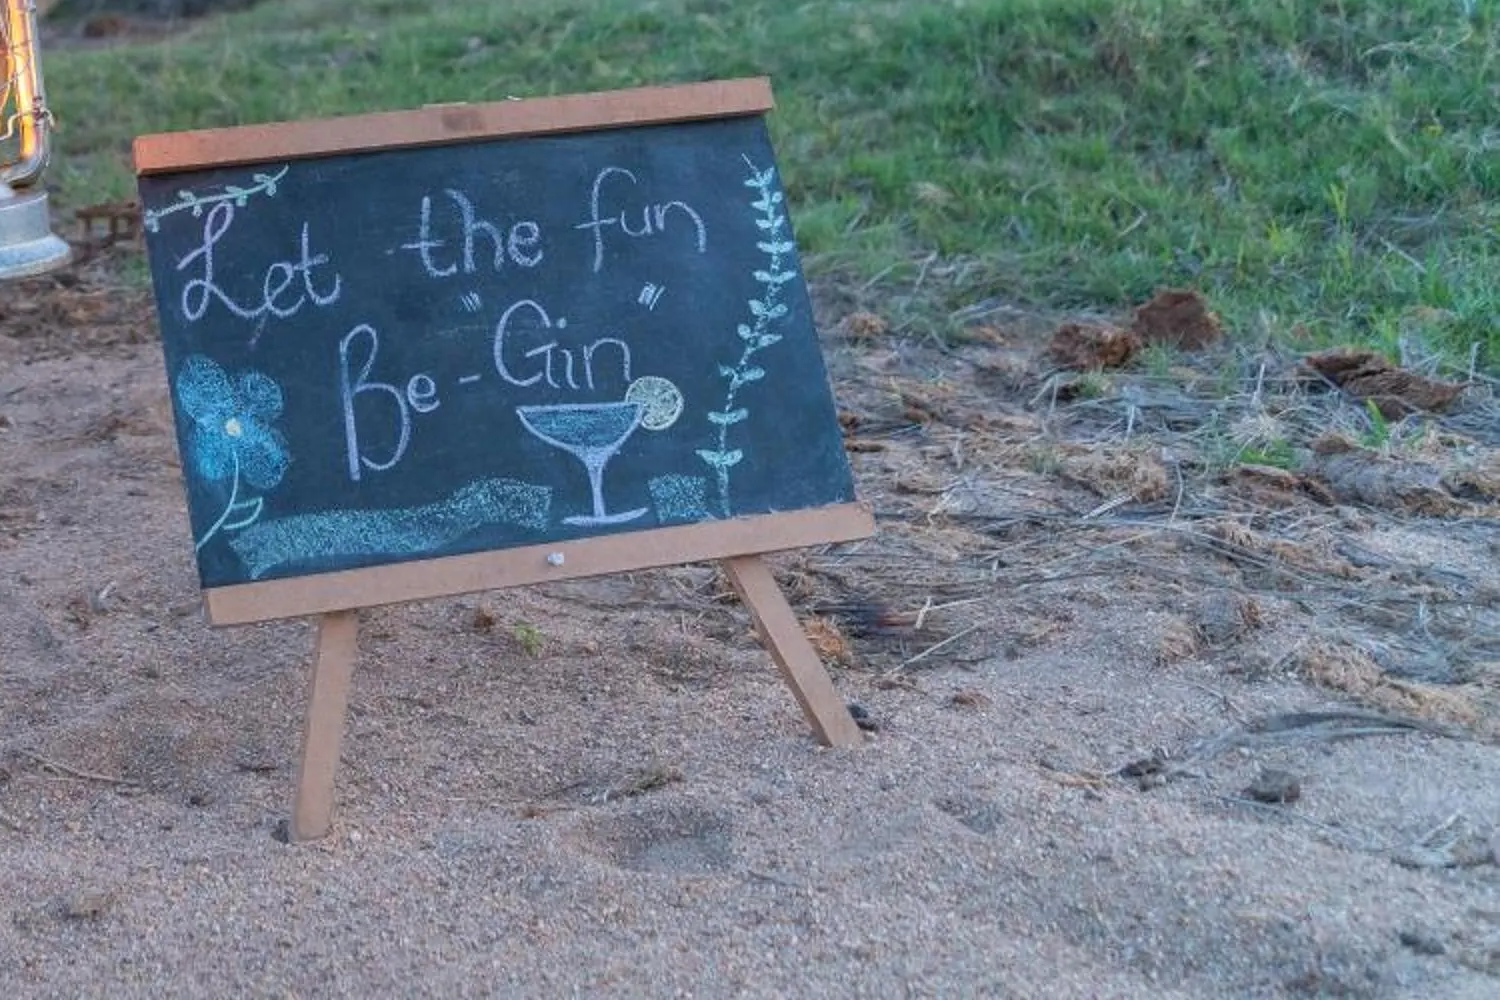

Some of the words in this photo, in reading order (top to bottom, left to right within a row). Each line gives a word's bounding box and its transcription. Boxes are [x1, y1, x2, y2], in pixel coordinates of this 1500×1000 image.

[176, 201, 341, 319] Let
[401, 188, 543, 277] the
[574, 167, 706, 273] fun
